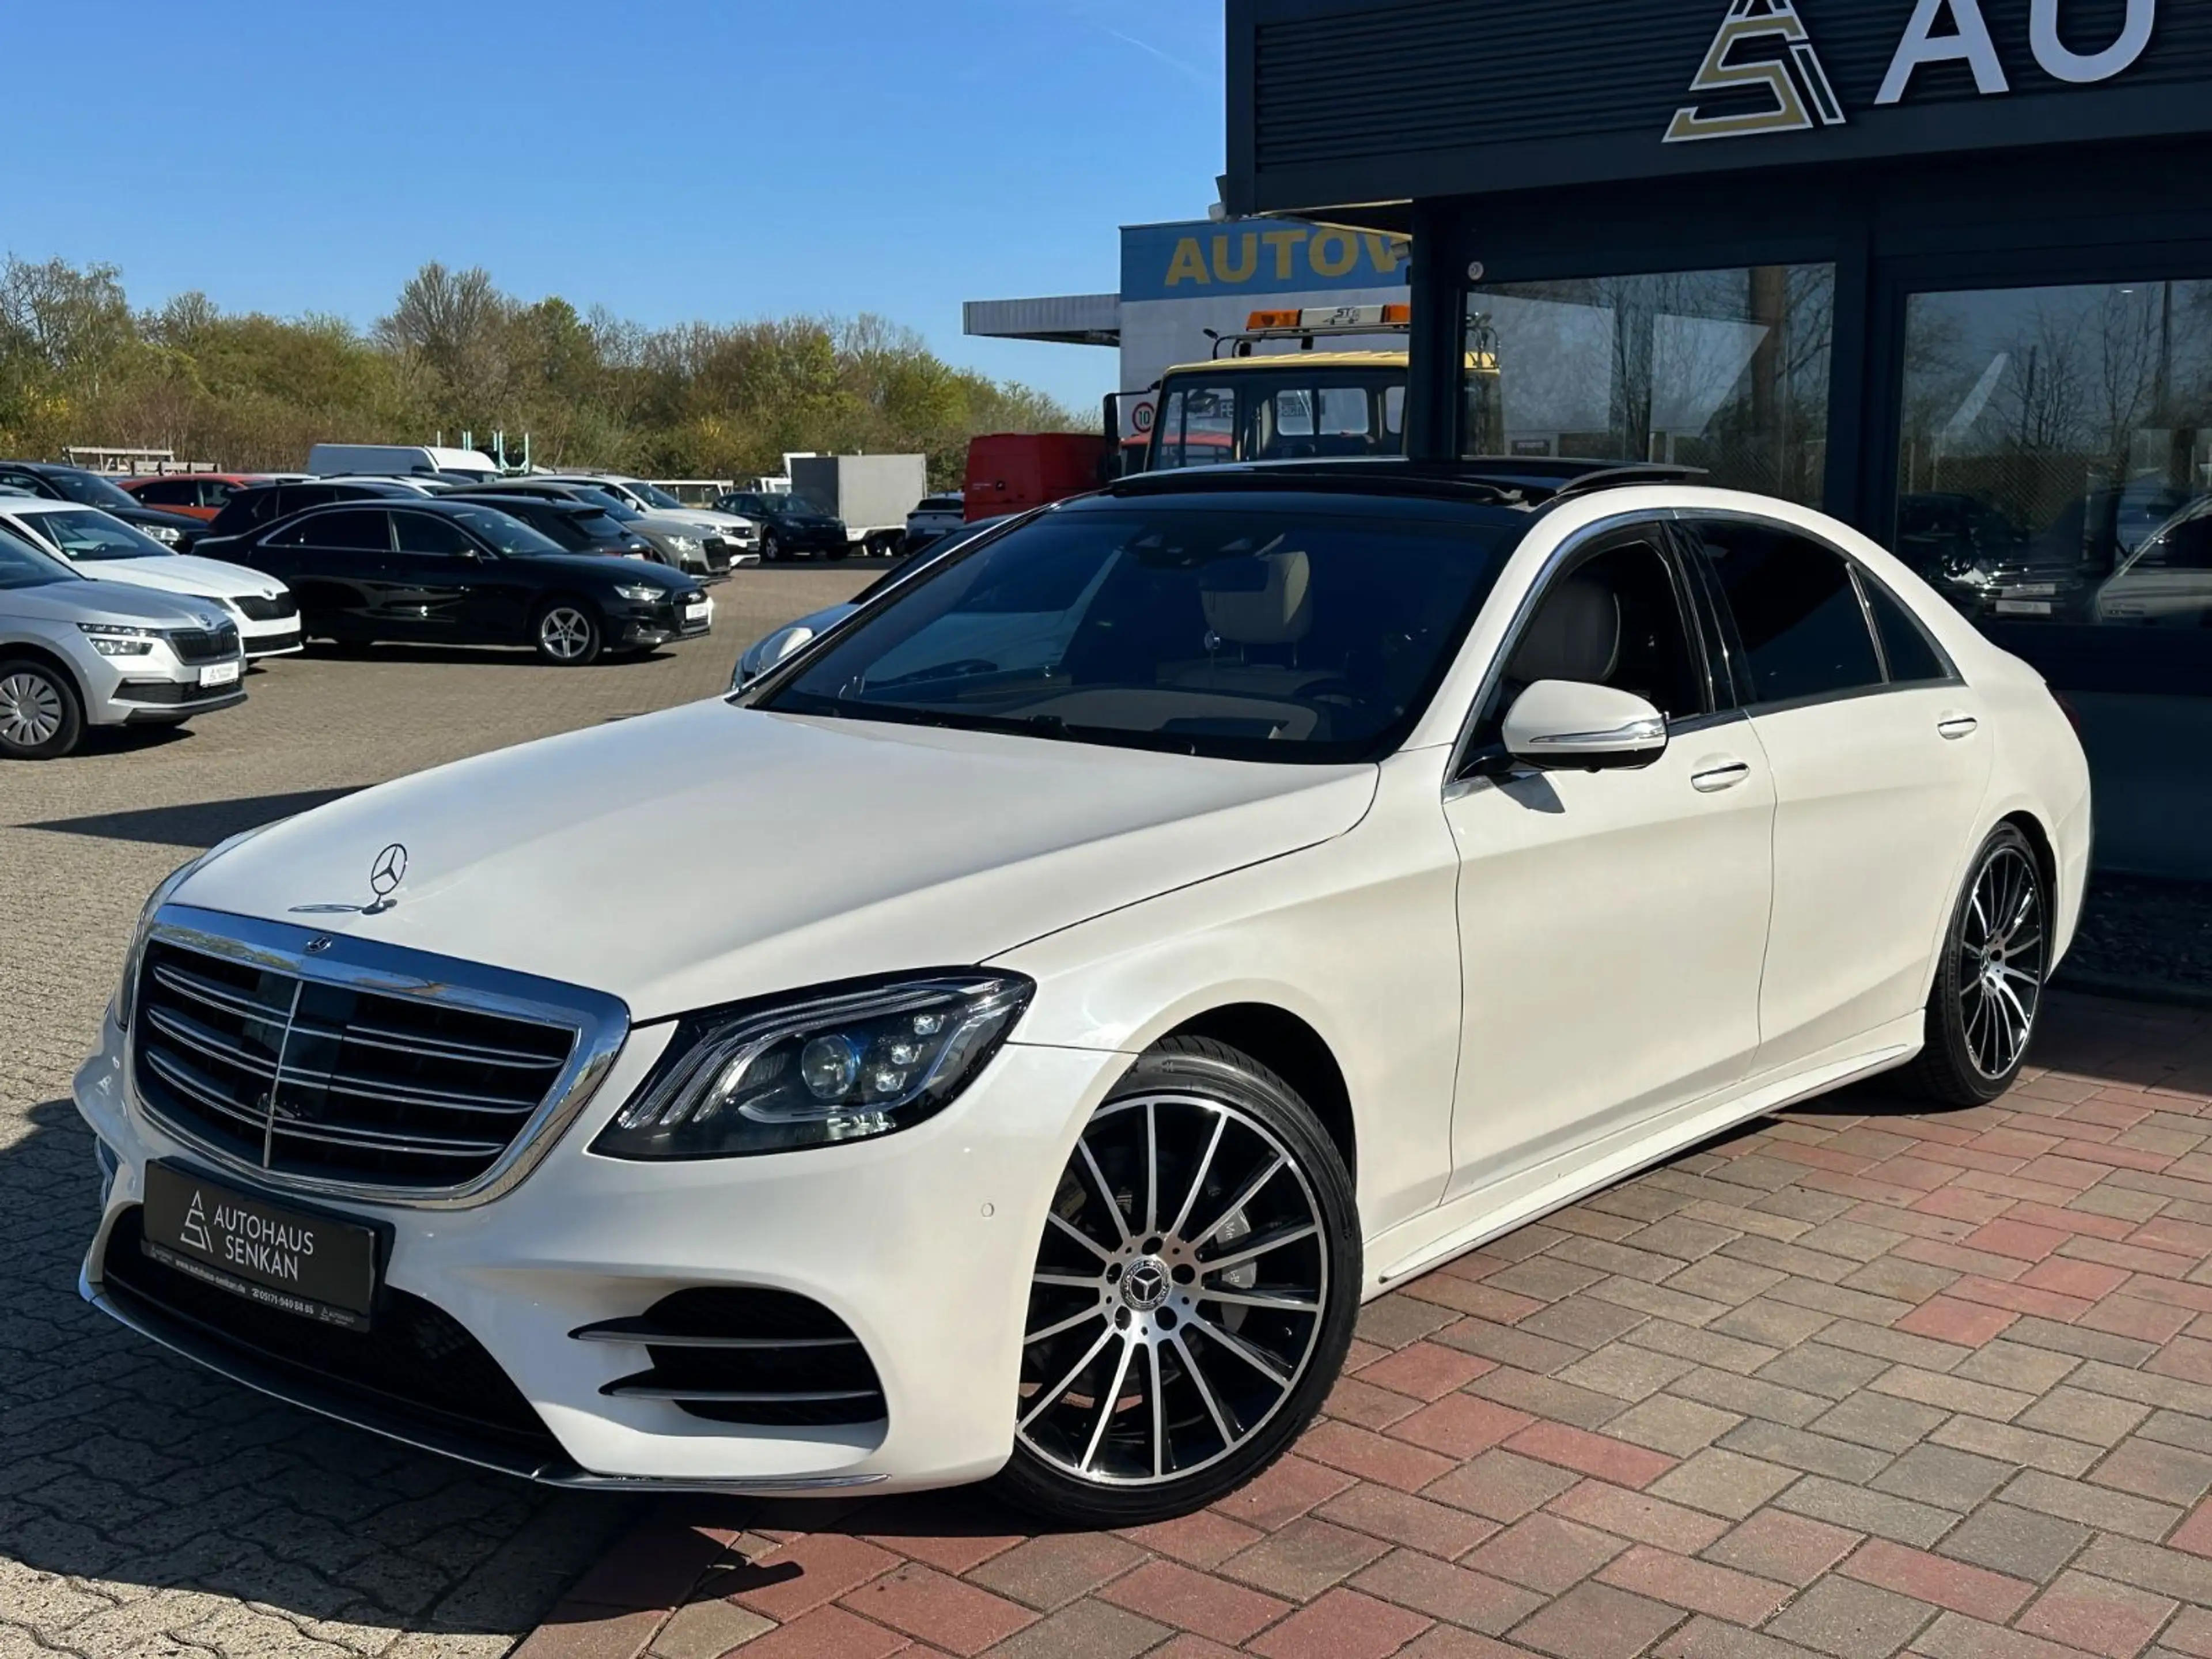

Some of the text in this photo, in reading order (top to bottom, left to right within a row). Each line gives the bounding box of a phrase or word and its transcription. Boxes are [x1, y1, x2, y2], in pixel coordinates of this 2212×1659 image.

[1139, 411, 1150, 425] 10
[214, 1205, 314, 1255] AUTOHAUS
[225, 1234, 298, 1282] SENKAN
